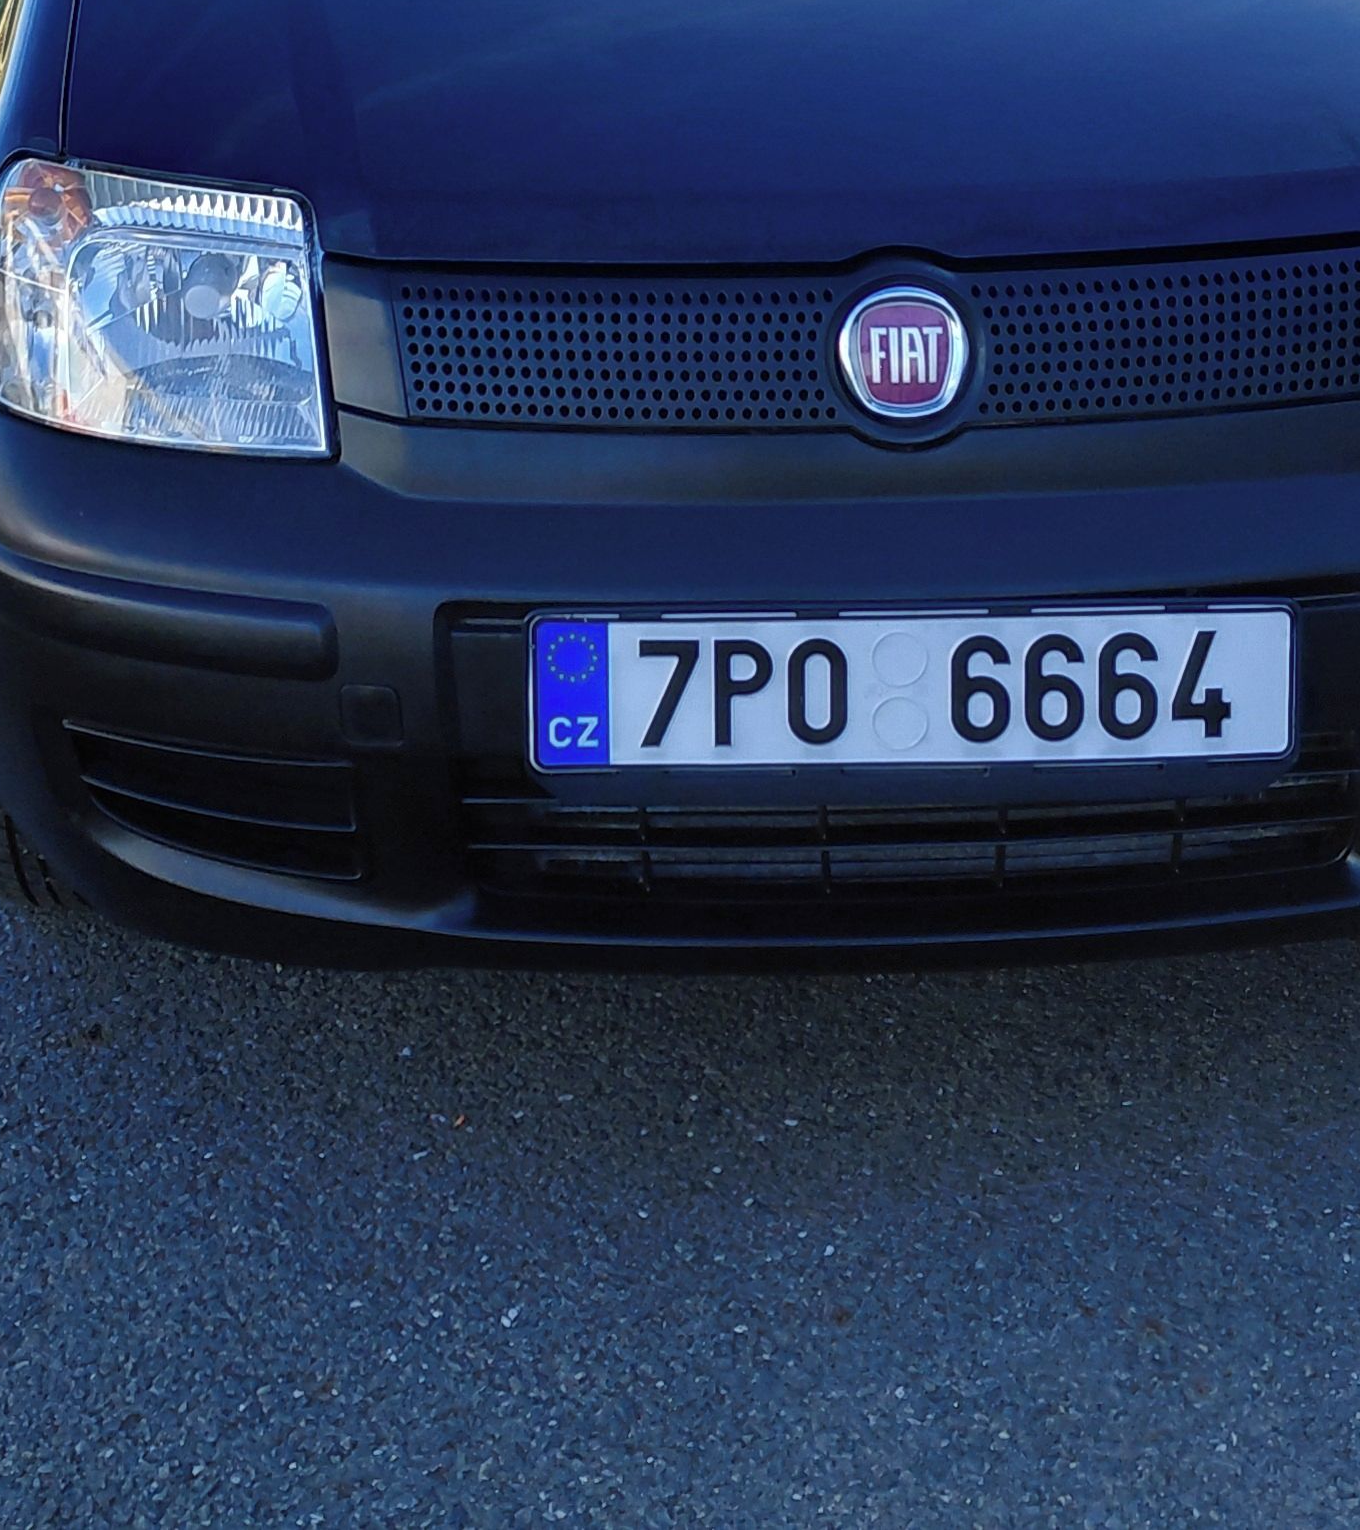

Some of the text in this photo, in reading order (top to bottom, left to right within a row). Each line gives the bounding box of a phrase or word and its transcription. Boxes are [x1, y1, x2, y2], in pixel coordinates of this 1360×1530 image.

[868, 324, 943, 386] FIAT
[949, 630, 1233, 743] 6664
[548, 715, 600, 748] CZ
